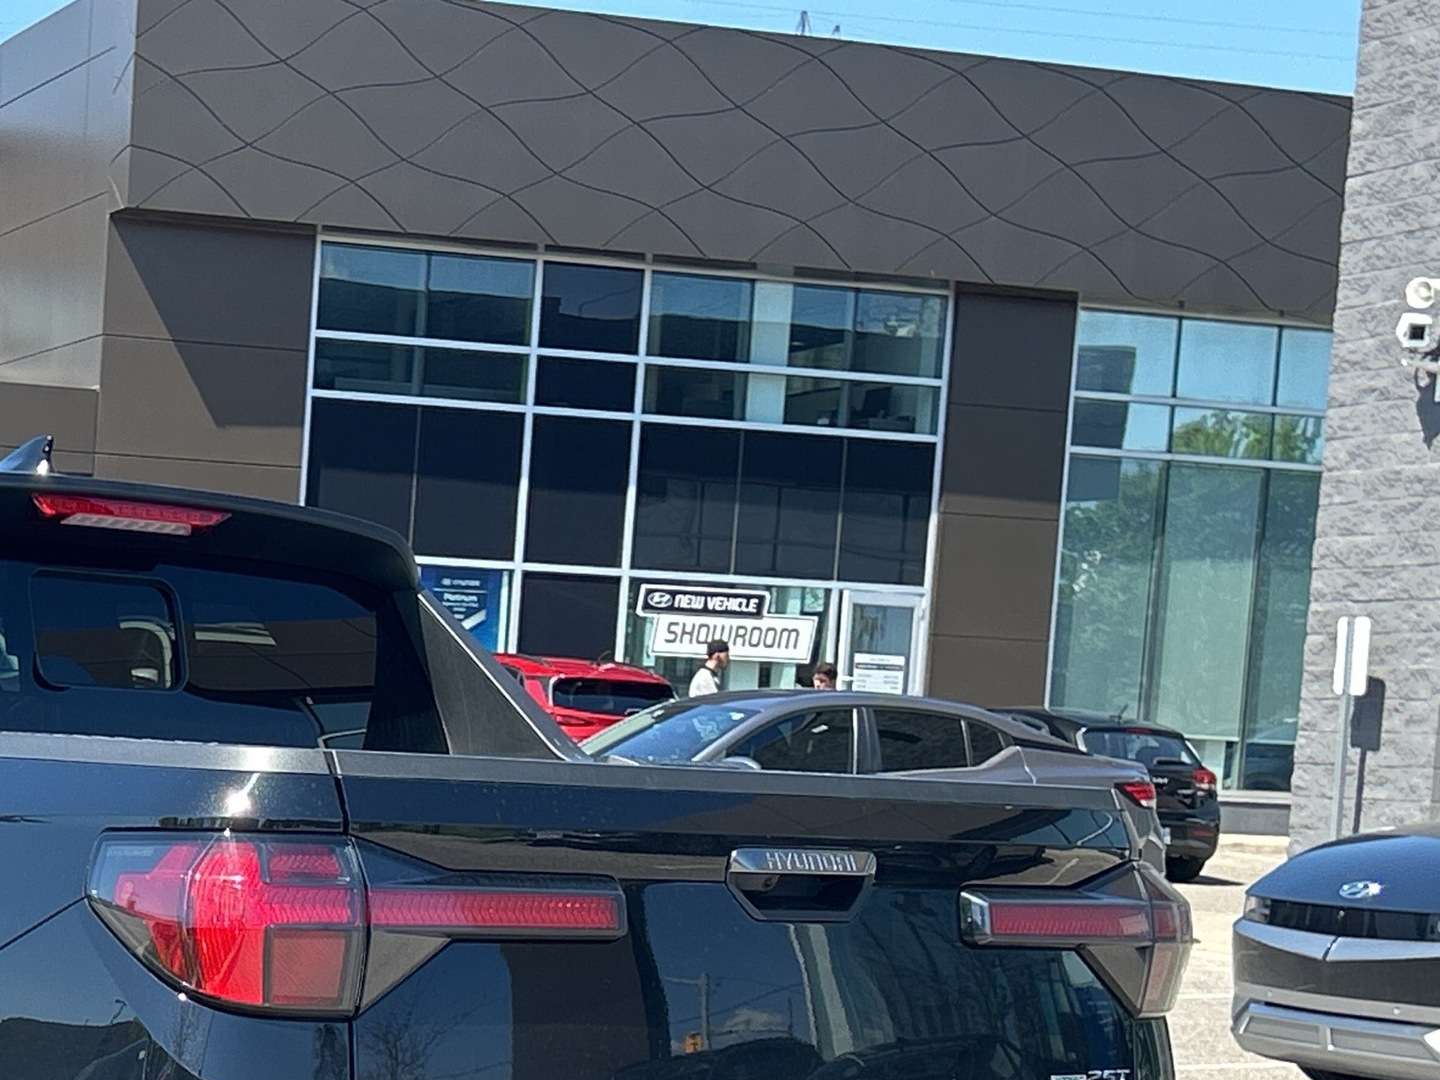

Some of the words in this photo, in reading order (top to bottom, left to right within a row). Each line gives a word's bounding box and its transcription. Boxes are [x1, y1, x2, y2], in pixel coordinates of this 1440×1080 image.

[674, 593, 705, 609] NEW
[707, 596, 759, 613] VEHICLE
[664, 621, 800, 650] SHOWROOM
[766, 851, 857, 872] HYUNDAI
